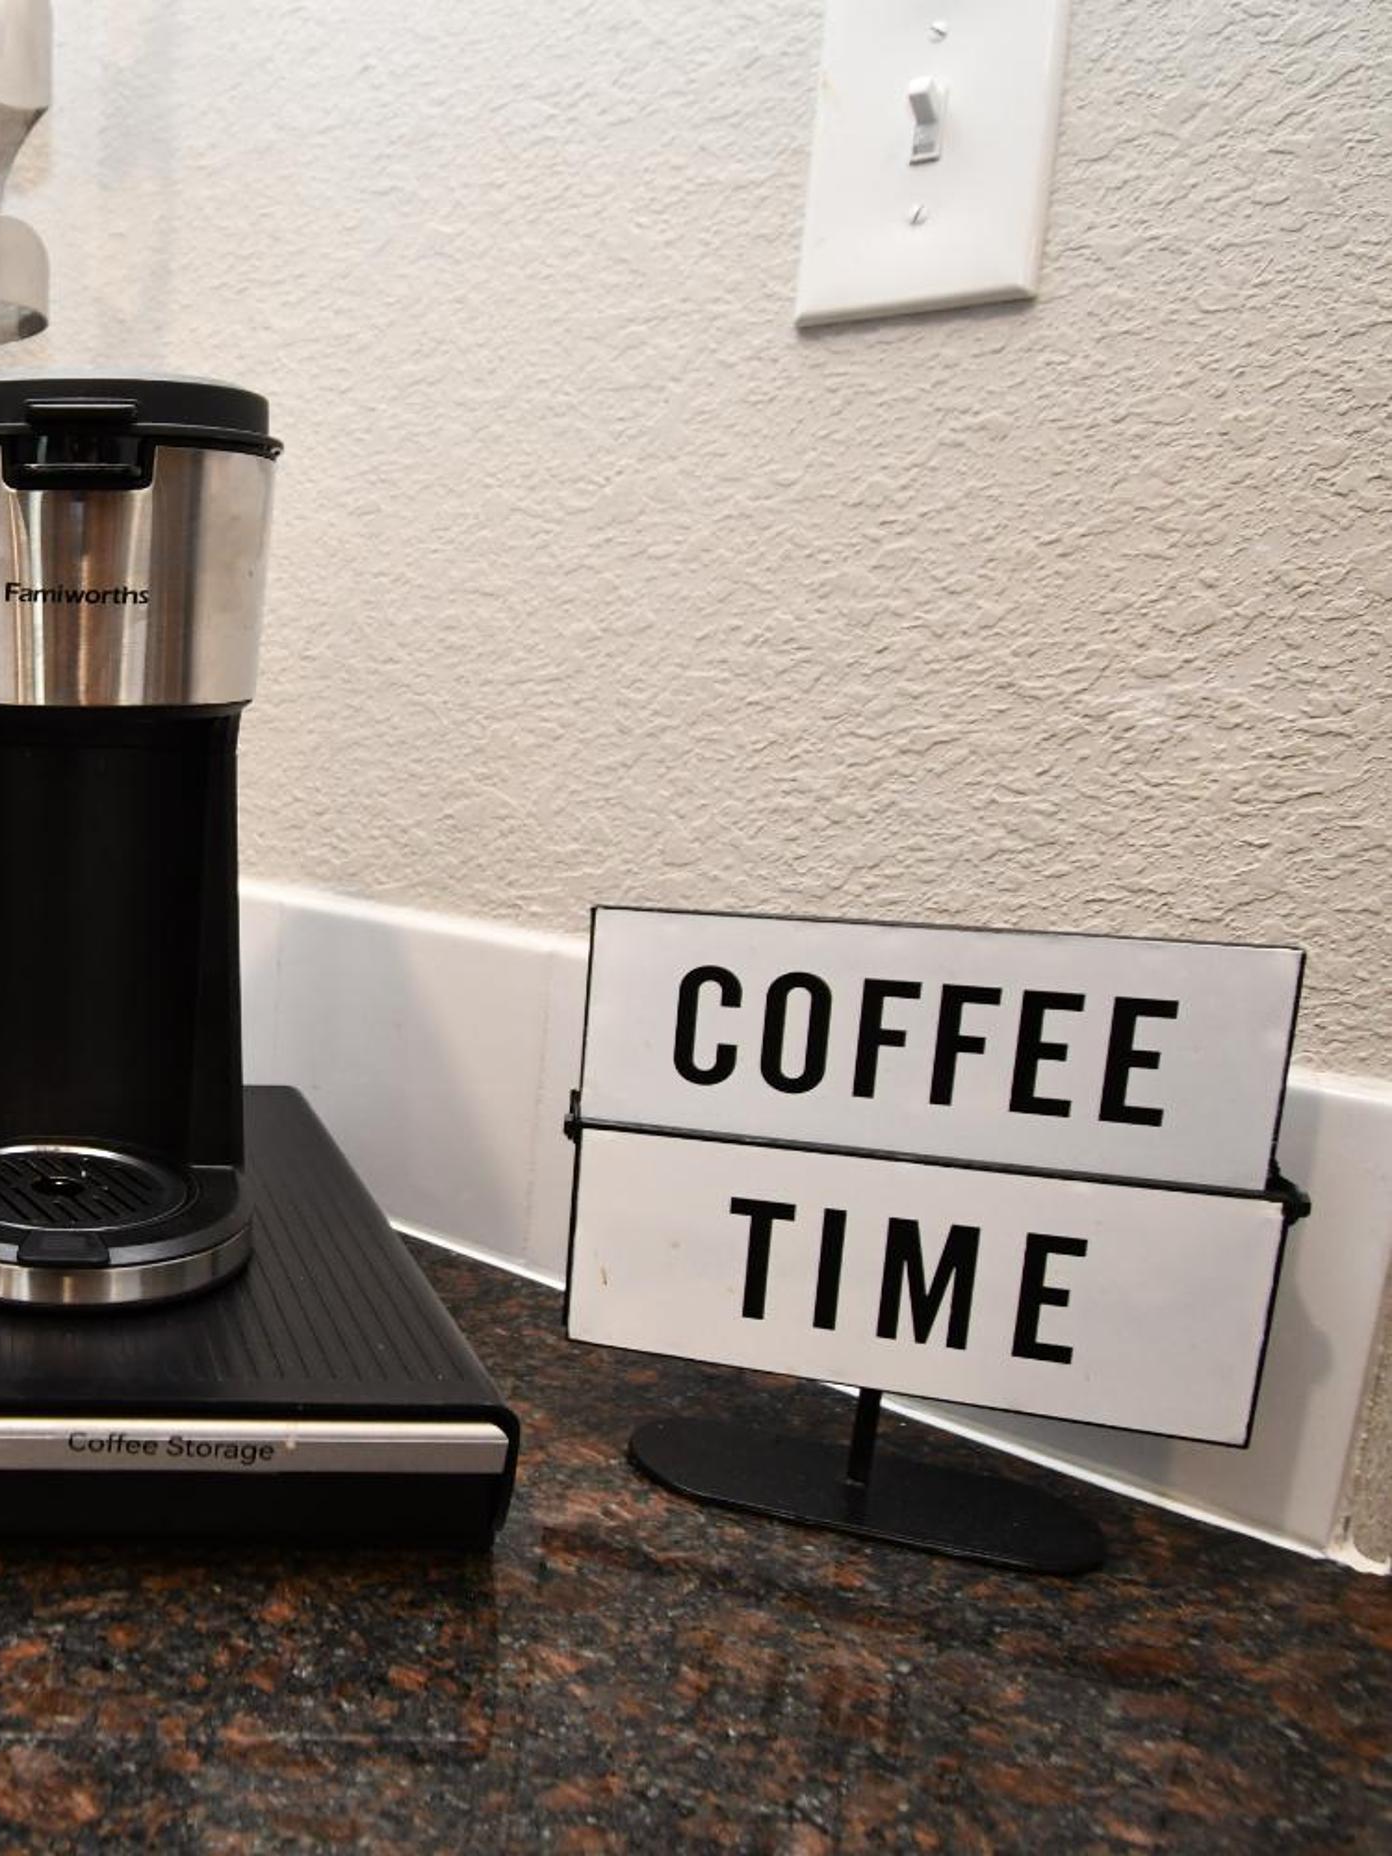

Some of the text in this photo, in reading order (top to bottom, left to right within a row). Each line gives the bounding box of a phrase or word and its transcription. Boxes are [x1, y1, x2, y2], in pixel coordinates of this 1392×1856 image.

[4, 582, 151, 604] Famiworths
[673, 964, 1179, 1127] COFFEE
[730, 1196, 1087, 1365] TIME
[67, 1432, 275, 1465] Coffee Storage
